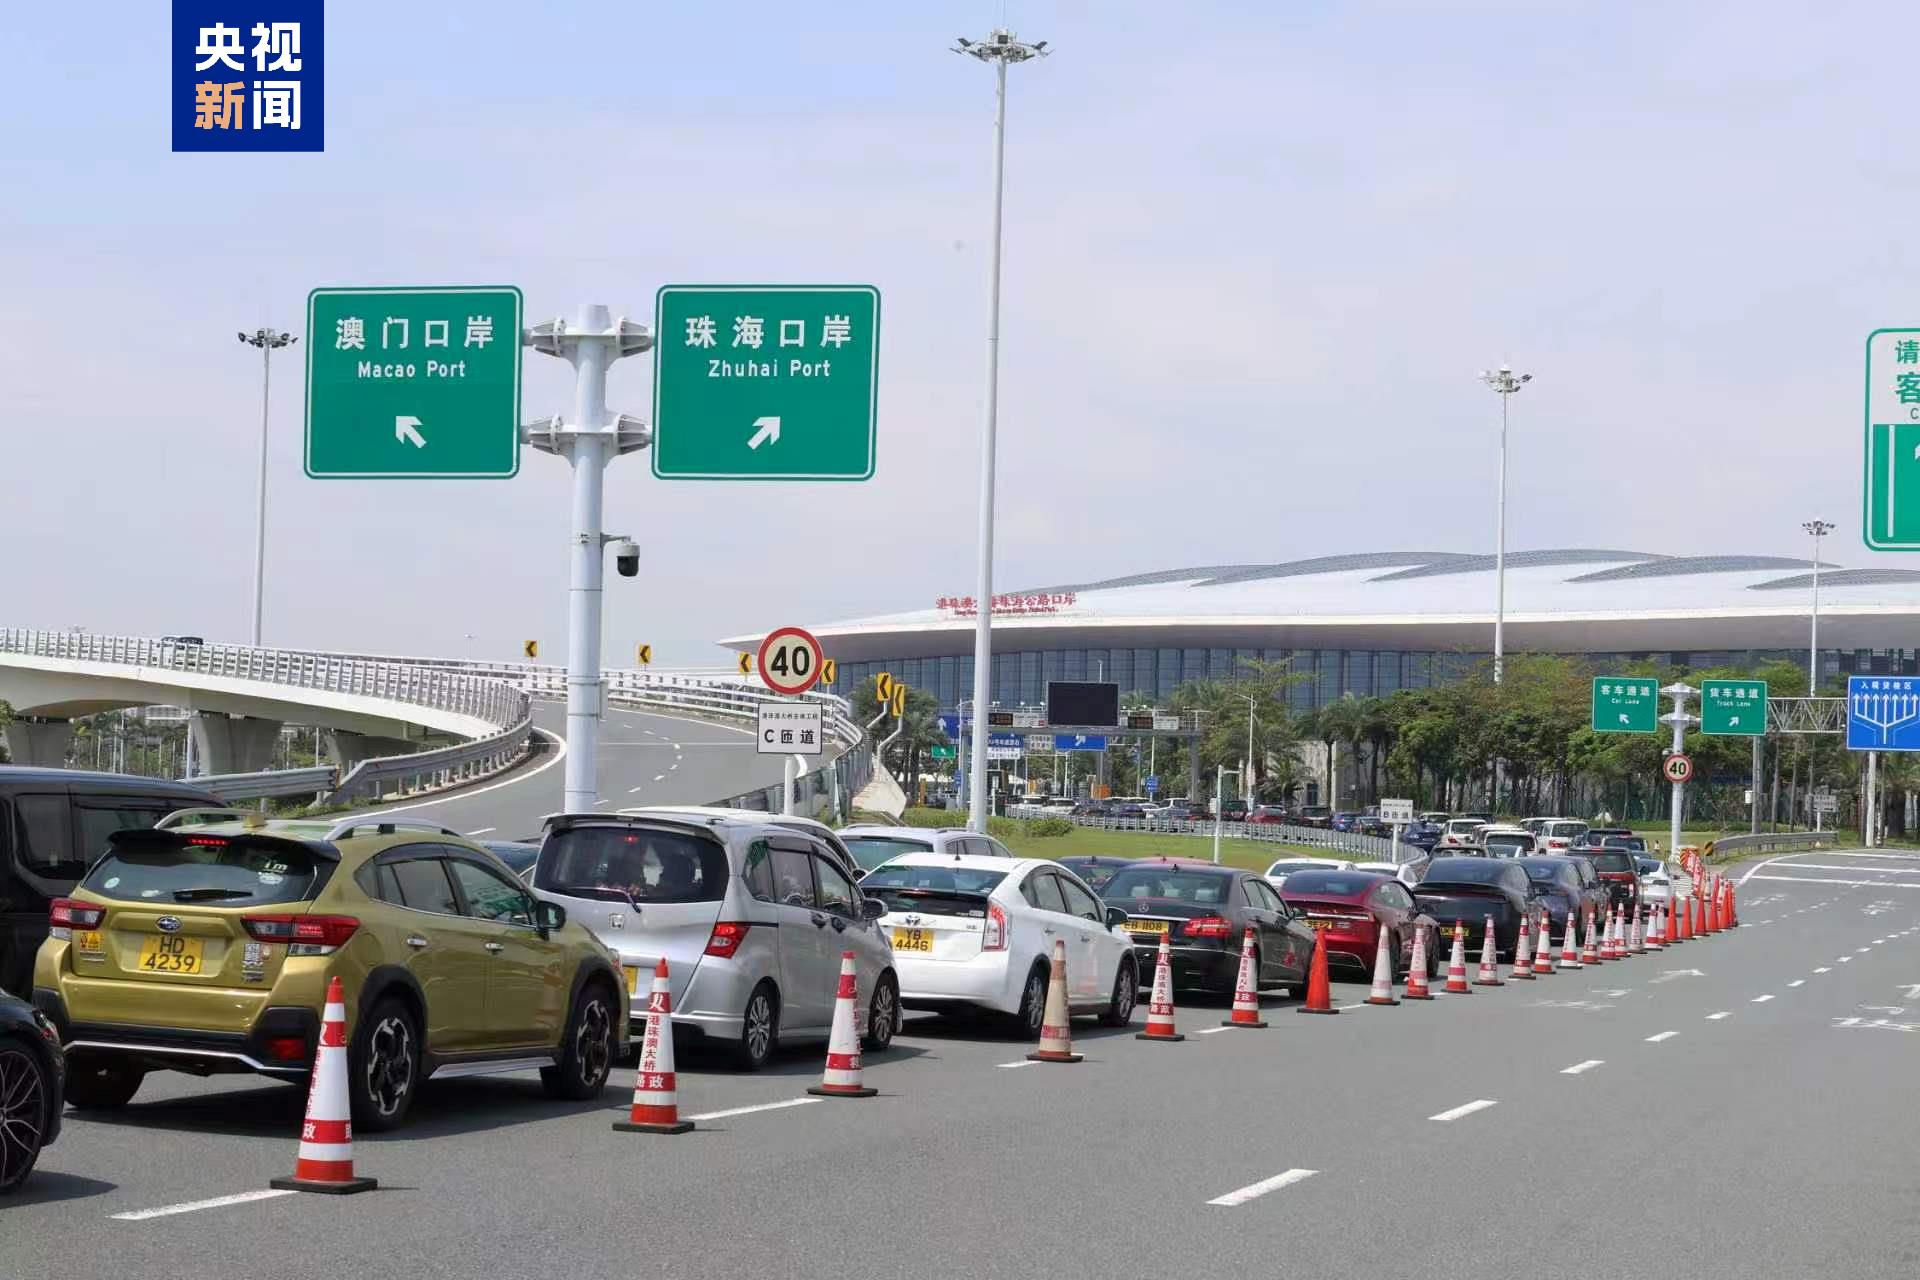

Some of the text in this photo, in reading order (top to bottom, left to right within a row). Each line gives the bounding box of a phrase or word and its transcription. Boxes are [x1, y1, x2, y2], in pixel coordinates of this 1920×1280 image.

[335, 315, 494, 350] 澳门口岸
[684, 314, 852, 349] 珠海口岸
[357, 360, 466, 378] Macao Port
[708, 359, 831, 377] Zhuhai Port
[771, 645, 810, 676] 40
[1600, 684, 1650, 697] 客车通道
[1709, 687, 1760, 699] 货车通道
[764, 729, 815, 744] C 匝道
[1669, 761, 1687, 775] 40
[905, 929, 922, 941] YB
[159, 936, 185, 954] HD
[895, 940, 929, 951] 4446
[144, 953, 196, 972] 4239
[644, 1015, 660, 1071] 港珠澳大桥
